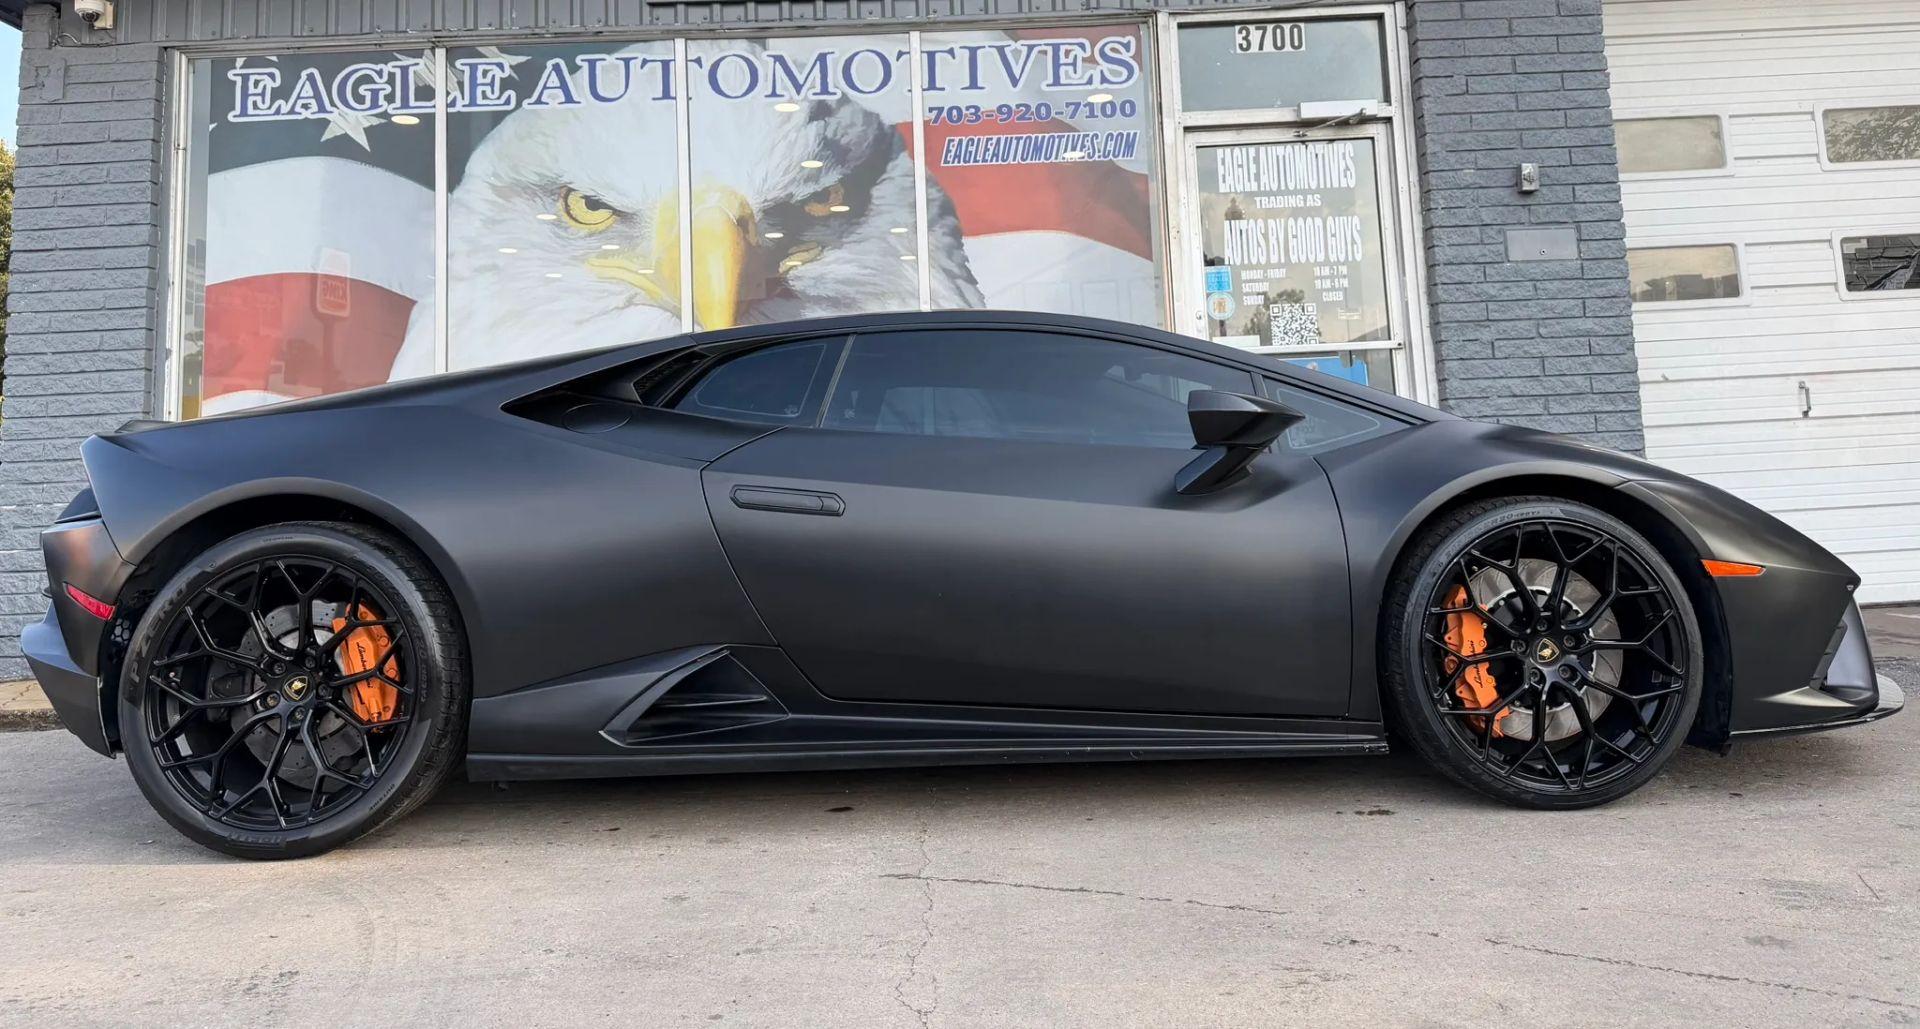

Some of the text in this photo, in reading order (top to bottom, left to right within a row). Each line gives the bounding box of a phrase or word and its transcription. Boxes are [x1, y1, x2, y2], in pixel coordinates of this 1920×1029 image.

[1237, 24, 1303, 51] 3700
[231, 37, 1139, 120] EAGLE AUTOMOTIVES
[927, 98, 1137, 125] 703-920-7100
[943, 131, 1138, 165] EAGLEAUTOMOTIVES.COM
[1216, 142, 1356, 193] EAGLE AUTOMOTIVES
[1254, 194, 1322, 209] TRADING AS
[1223, 215, 1362, 266] AUTOS BY GOOD GUYS
